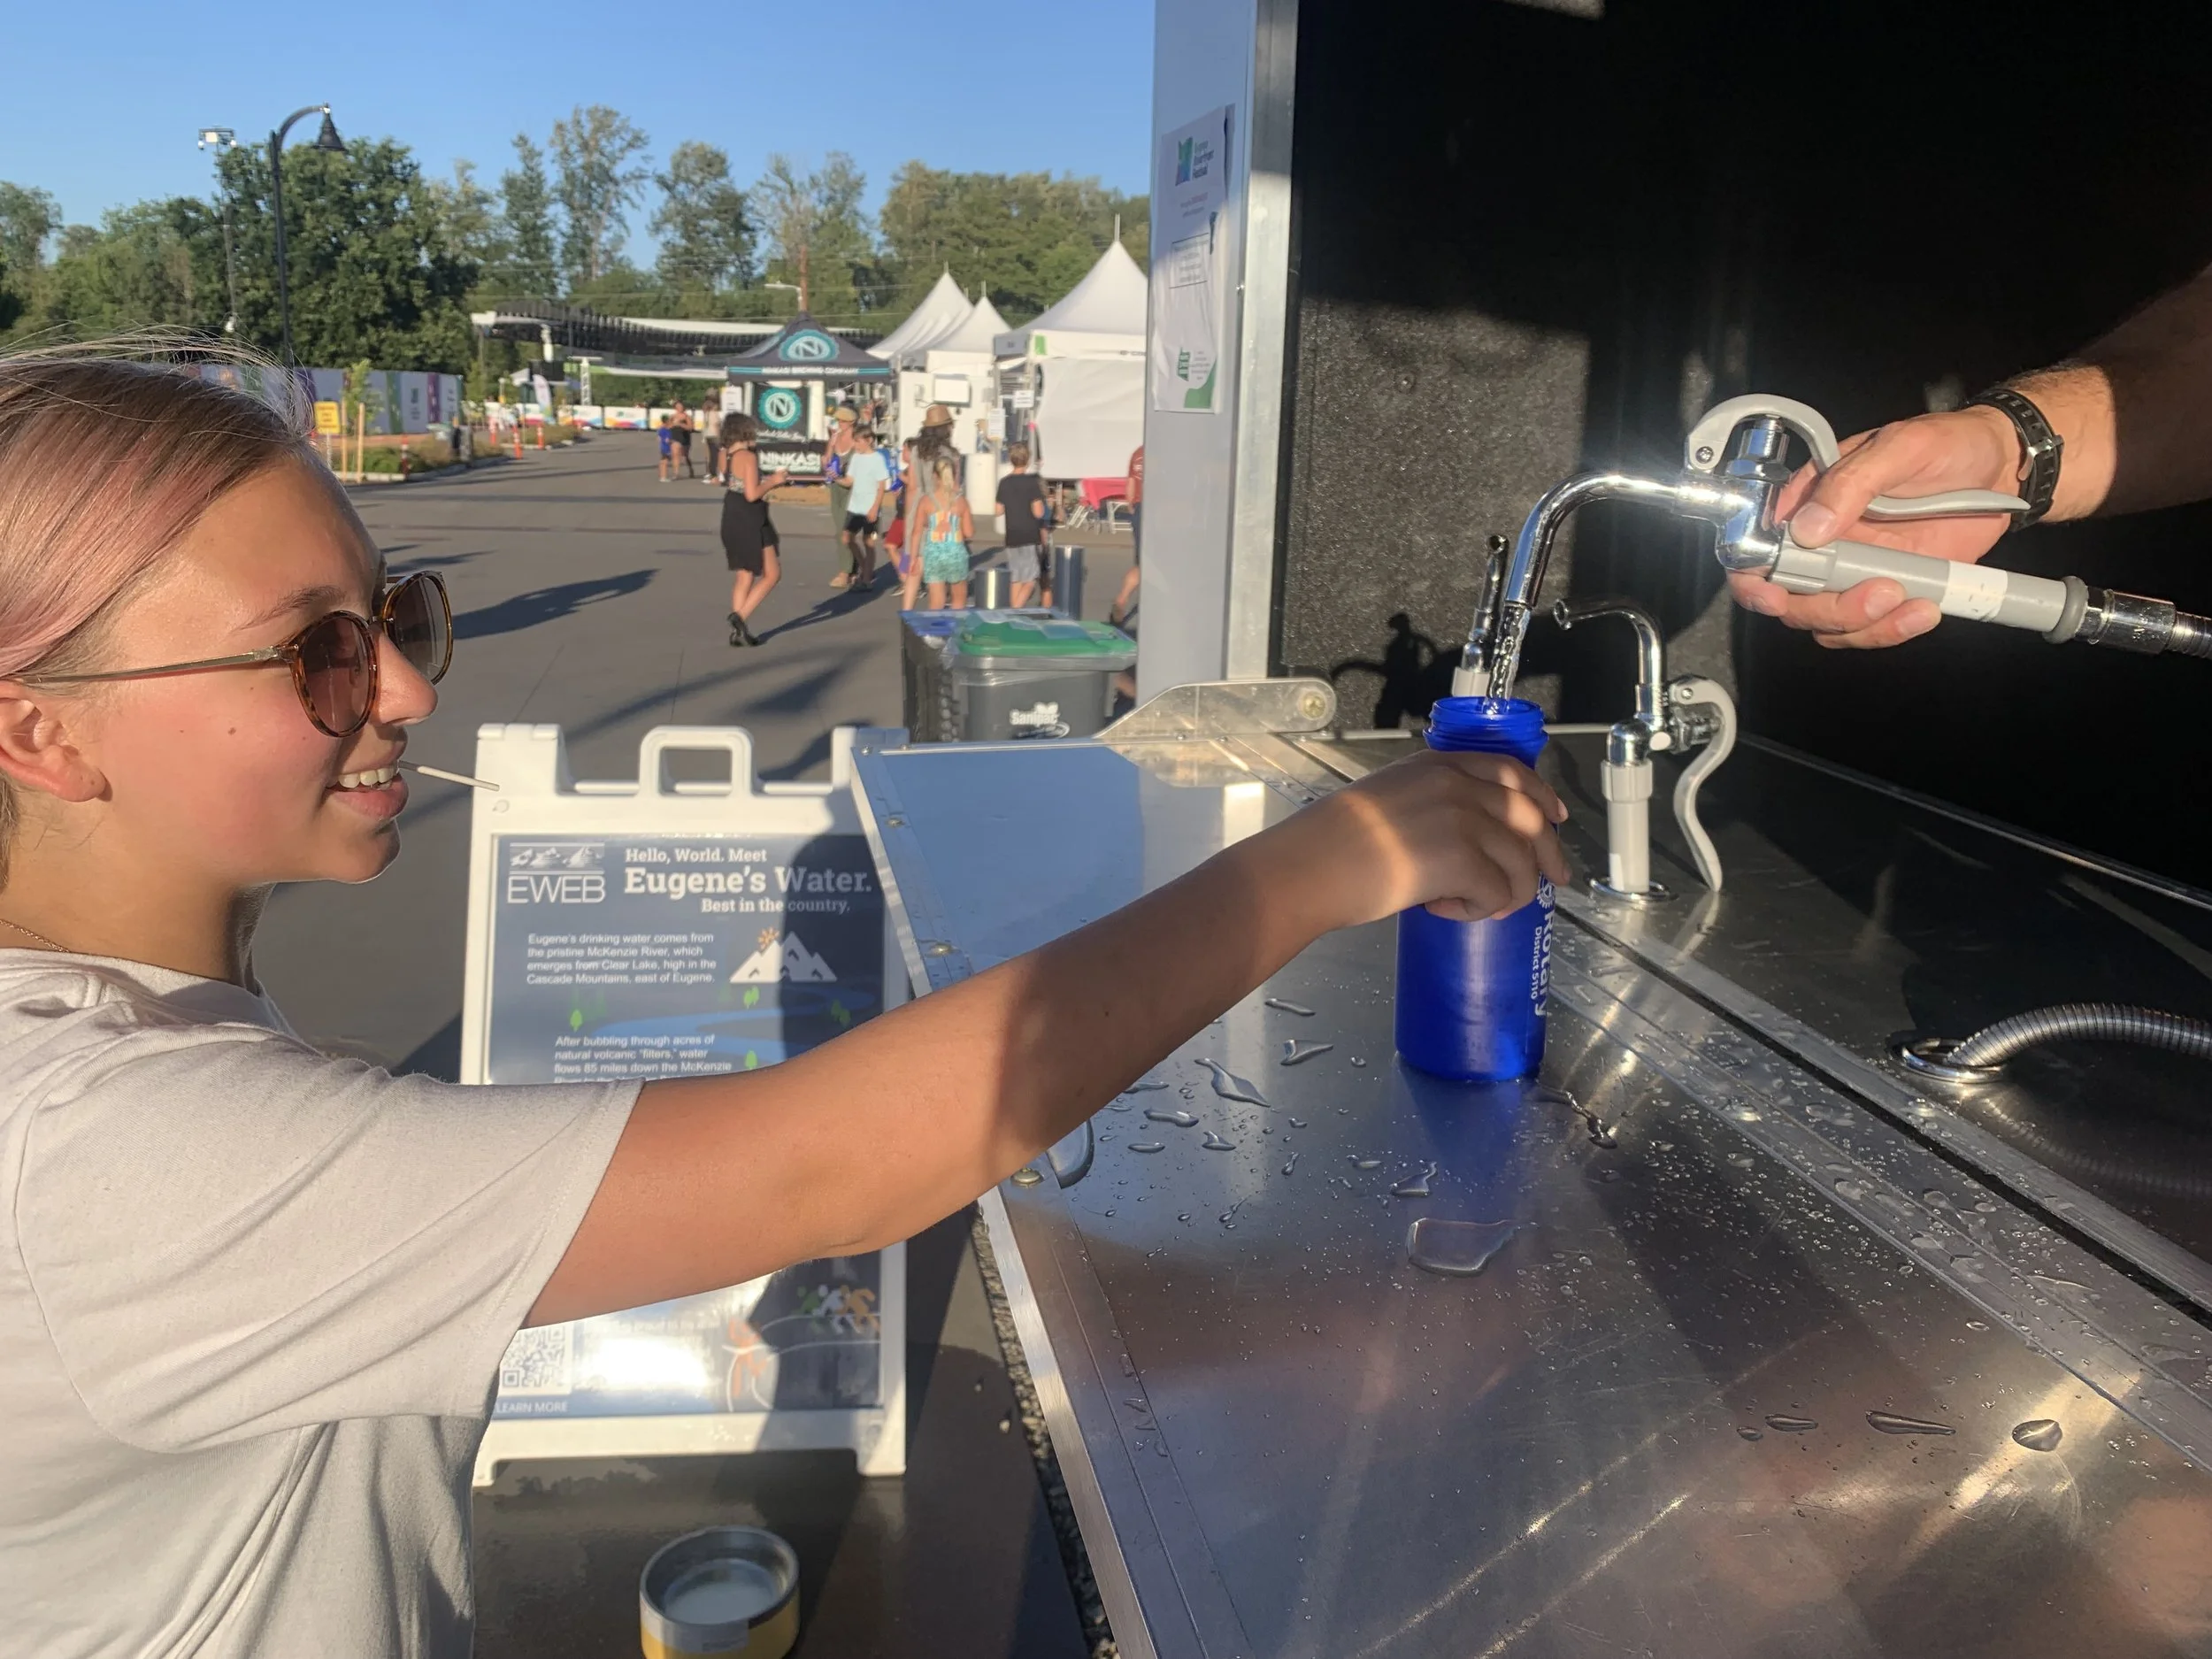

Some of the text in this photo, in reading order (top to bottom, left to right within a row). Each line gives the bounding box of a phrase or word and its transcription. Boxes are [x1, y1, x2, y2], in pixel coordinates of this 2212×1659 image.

[625, 847, 767, 864] Hello, World. Meet
[507, 875, 606, 903] EWEB
[624, 865, 872, 901] Eugene's Water.
[701, 897, 736, 912] Best
[739, 897, 756, 912] in
[758, 897, 784, 912] the
[527, 932, 714, 946] Eugene's drinking water comes from
[527, 945, 703, 960] the pristine McKenzie River, which
[526, 958, 717, 973] emerges from Clear Lake, high in the
[1530, 926, 1543, 1000] District 5110
[526, 973, 572, 985] Cascade
[575, 973, 632, 985] Mountains,
[634, 973, 657, 984] east
[659, 972, 670, 983] of
[555, 1033, 716, 1048] After bubbling through acres of
[554, 1049, 591, 1060] natural
[593, 1048, 636, 1060] volcanic
[679, 1049, 709, 1058] water
[554, 1063, 581, 1074] flows
[600, 1062, 628, 1072] miles
[630, 1061, 658, 1072] down
[662, 1061, 678, 1071] the
[680, 1060, 733, 1071] McKenzie
[496, 1400, 569, 1414] LEARN MORE
